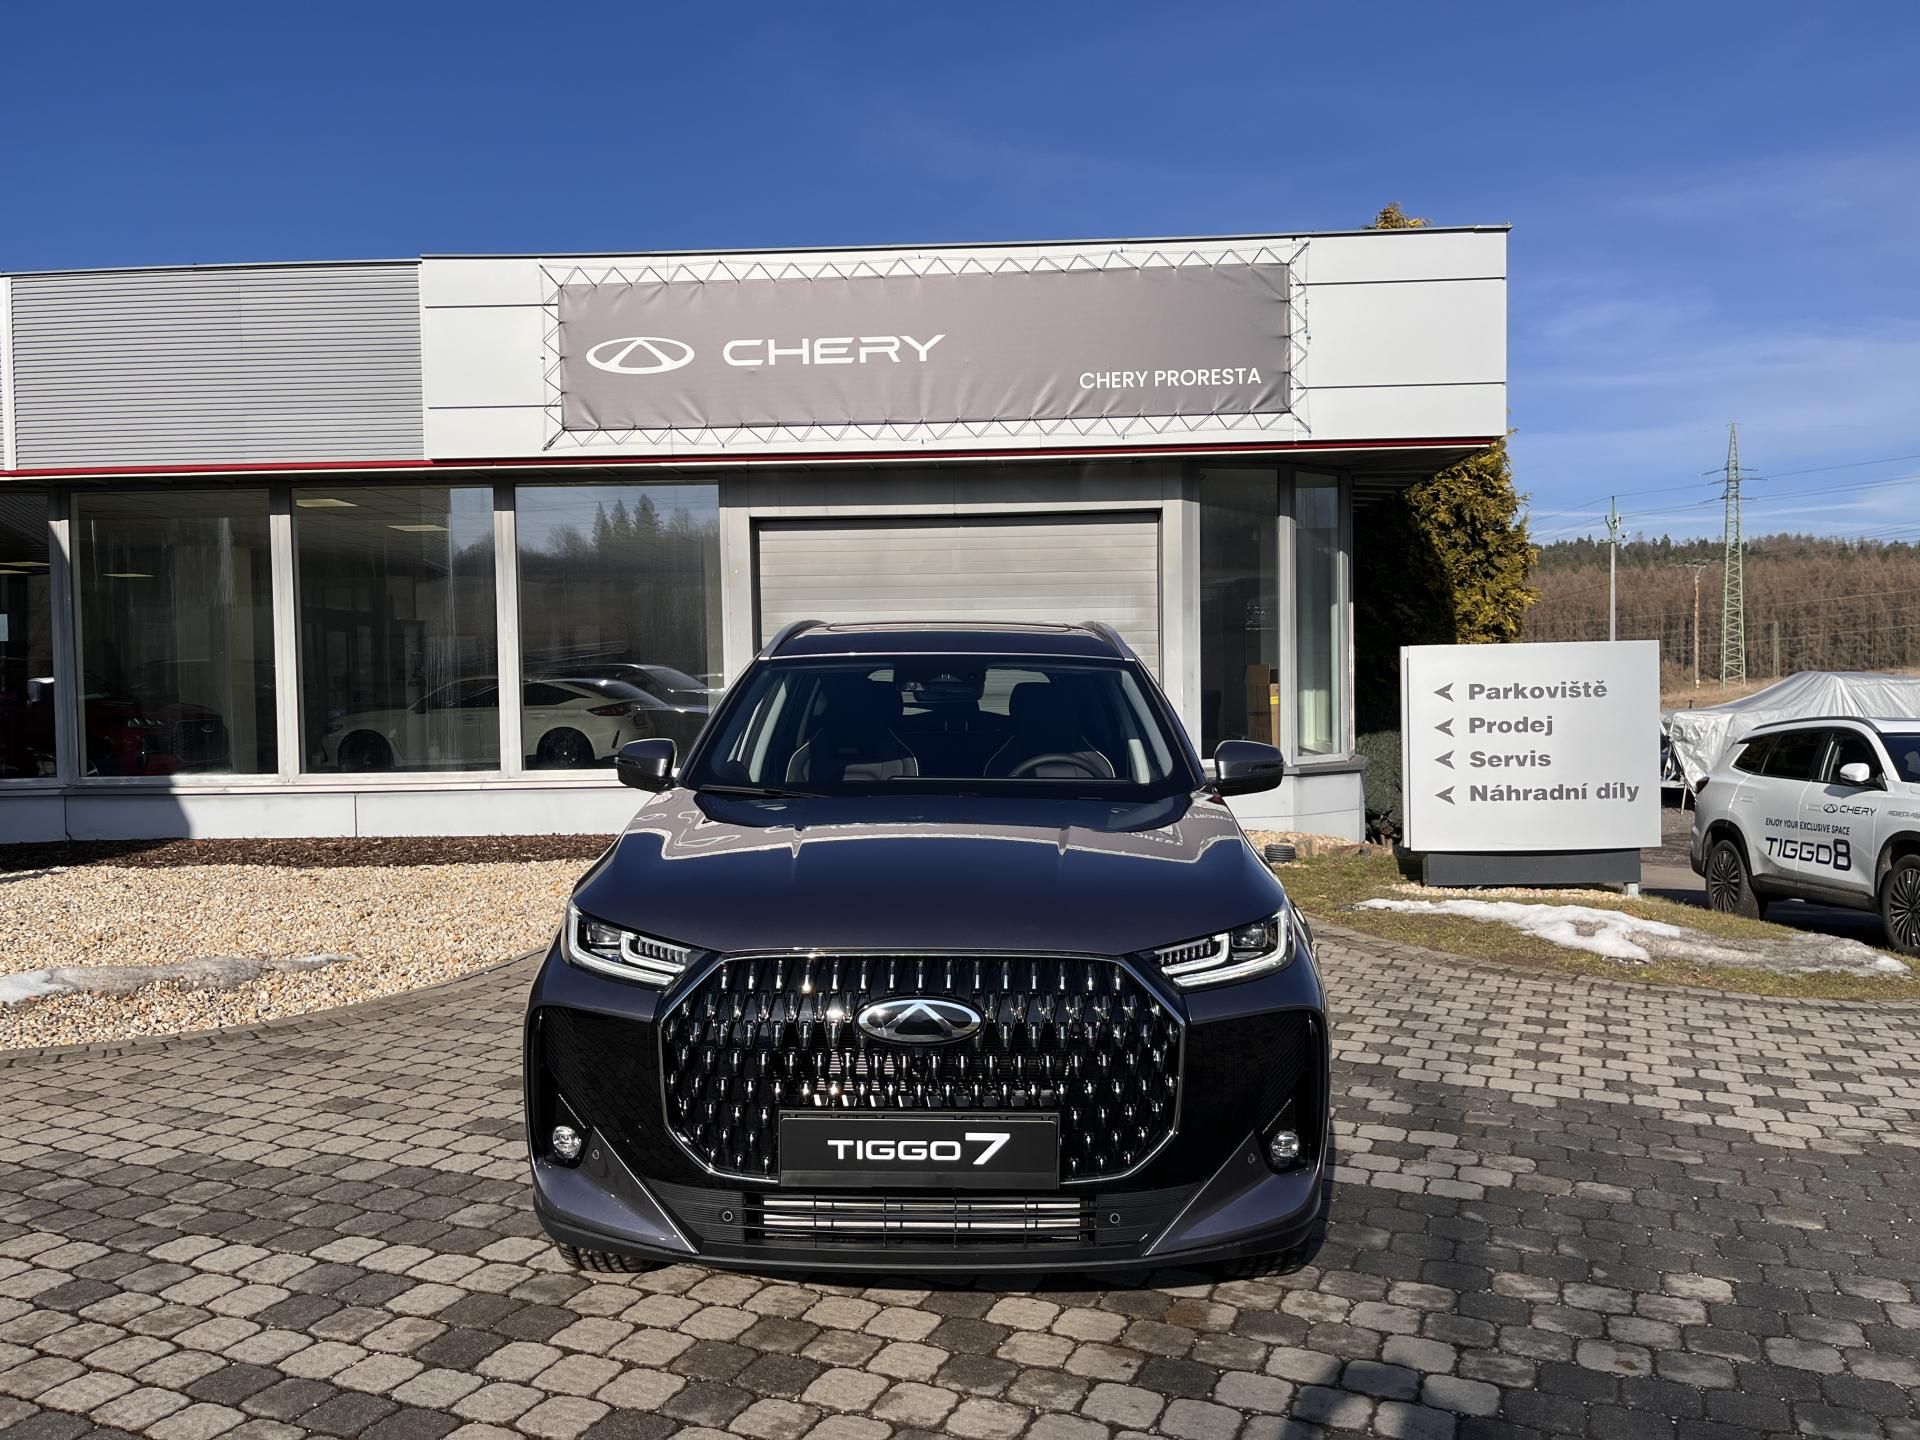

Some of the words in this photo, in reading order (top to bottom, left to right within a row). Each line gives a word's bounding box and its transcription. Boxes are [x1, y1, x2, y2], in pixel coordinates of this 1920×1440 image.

[723, 334, 946, 366] CHERY
[1079, 371, 1148, 389] CHERY
[1154, 367, 1262, 387] PRORESTA
[1468, 680, 1608, 700] Parkoviště
[1469, 715, 1553, 736] Prodej
[1469, 750, 1552, 768] Servis
[1469, 784, 1588, 802] Náhradní
[1596, 782, 1640, 803] díly
[1839, 804, 1877, 816] CHERY
[1765, 817, 1782, 827] ENJOY
[1783, 819, 1798, 829] YOUR
[1799, 821, 1830, 833] EXCLUSIVE
[1831, 825, 1850, 835] SPACE
